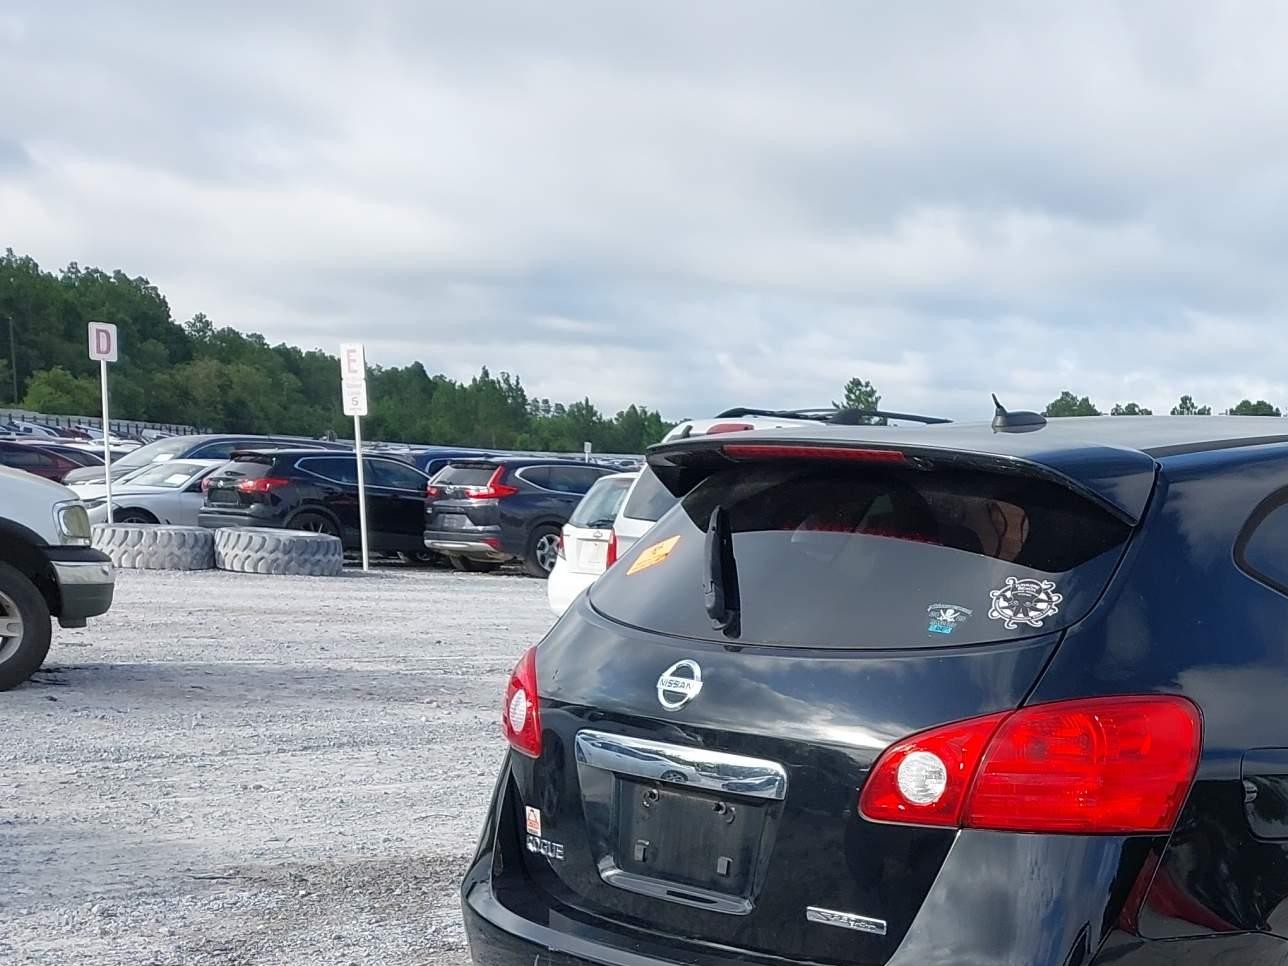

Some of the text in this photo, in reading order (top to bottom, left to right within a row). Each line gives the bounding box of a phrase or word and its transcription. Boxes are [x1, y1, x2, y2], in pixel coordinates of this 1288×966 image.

[95, 328, 111, 354] D
[346, 349, 358, 373] E
[660, 678, 697, 690] NISSAN
